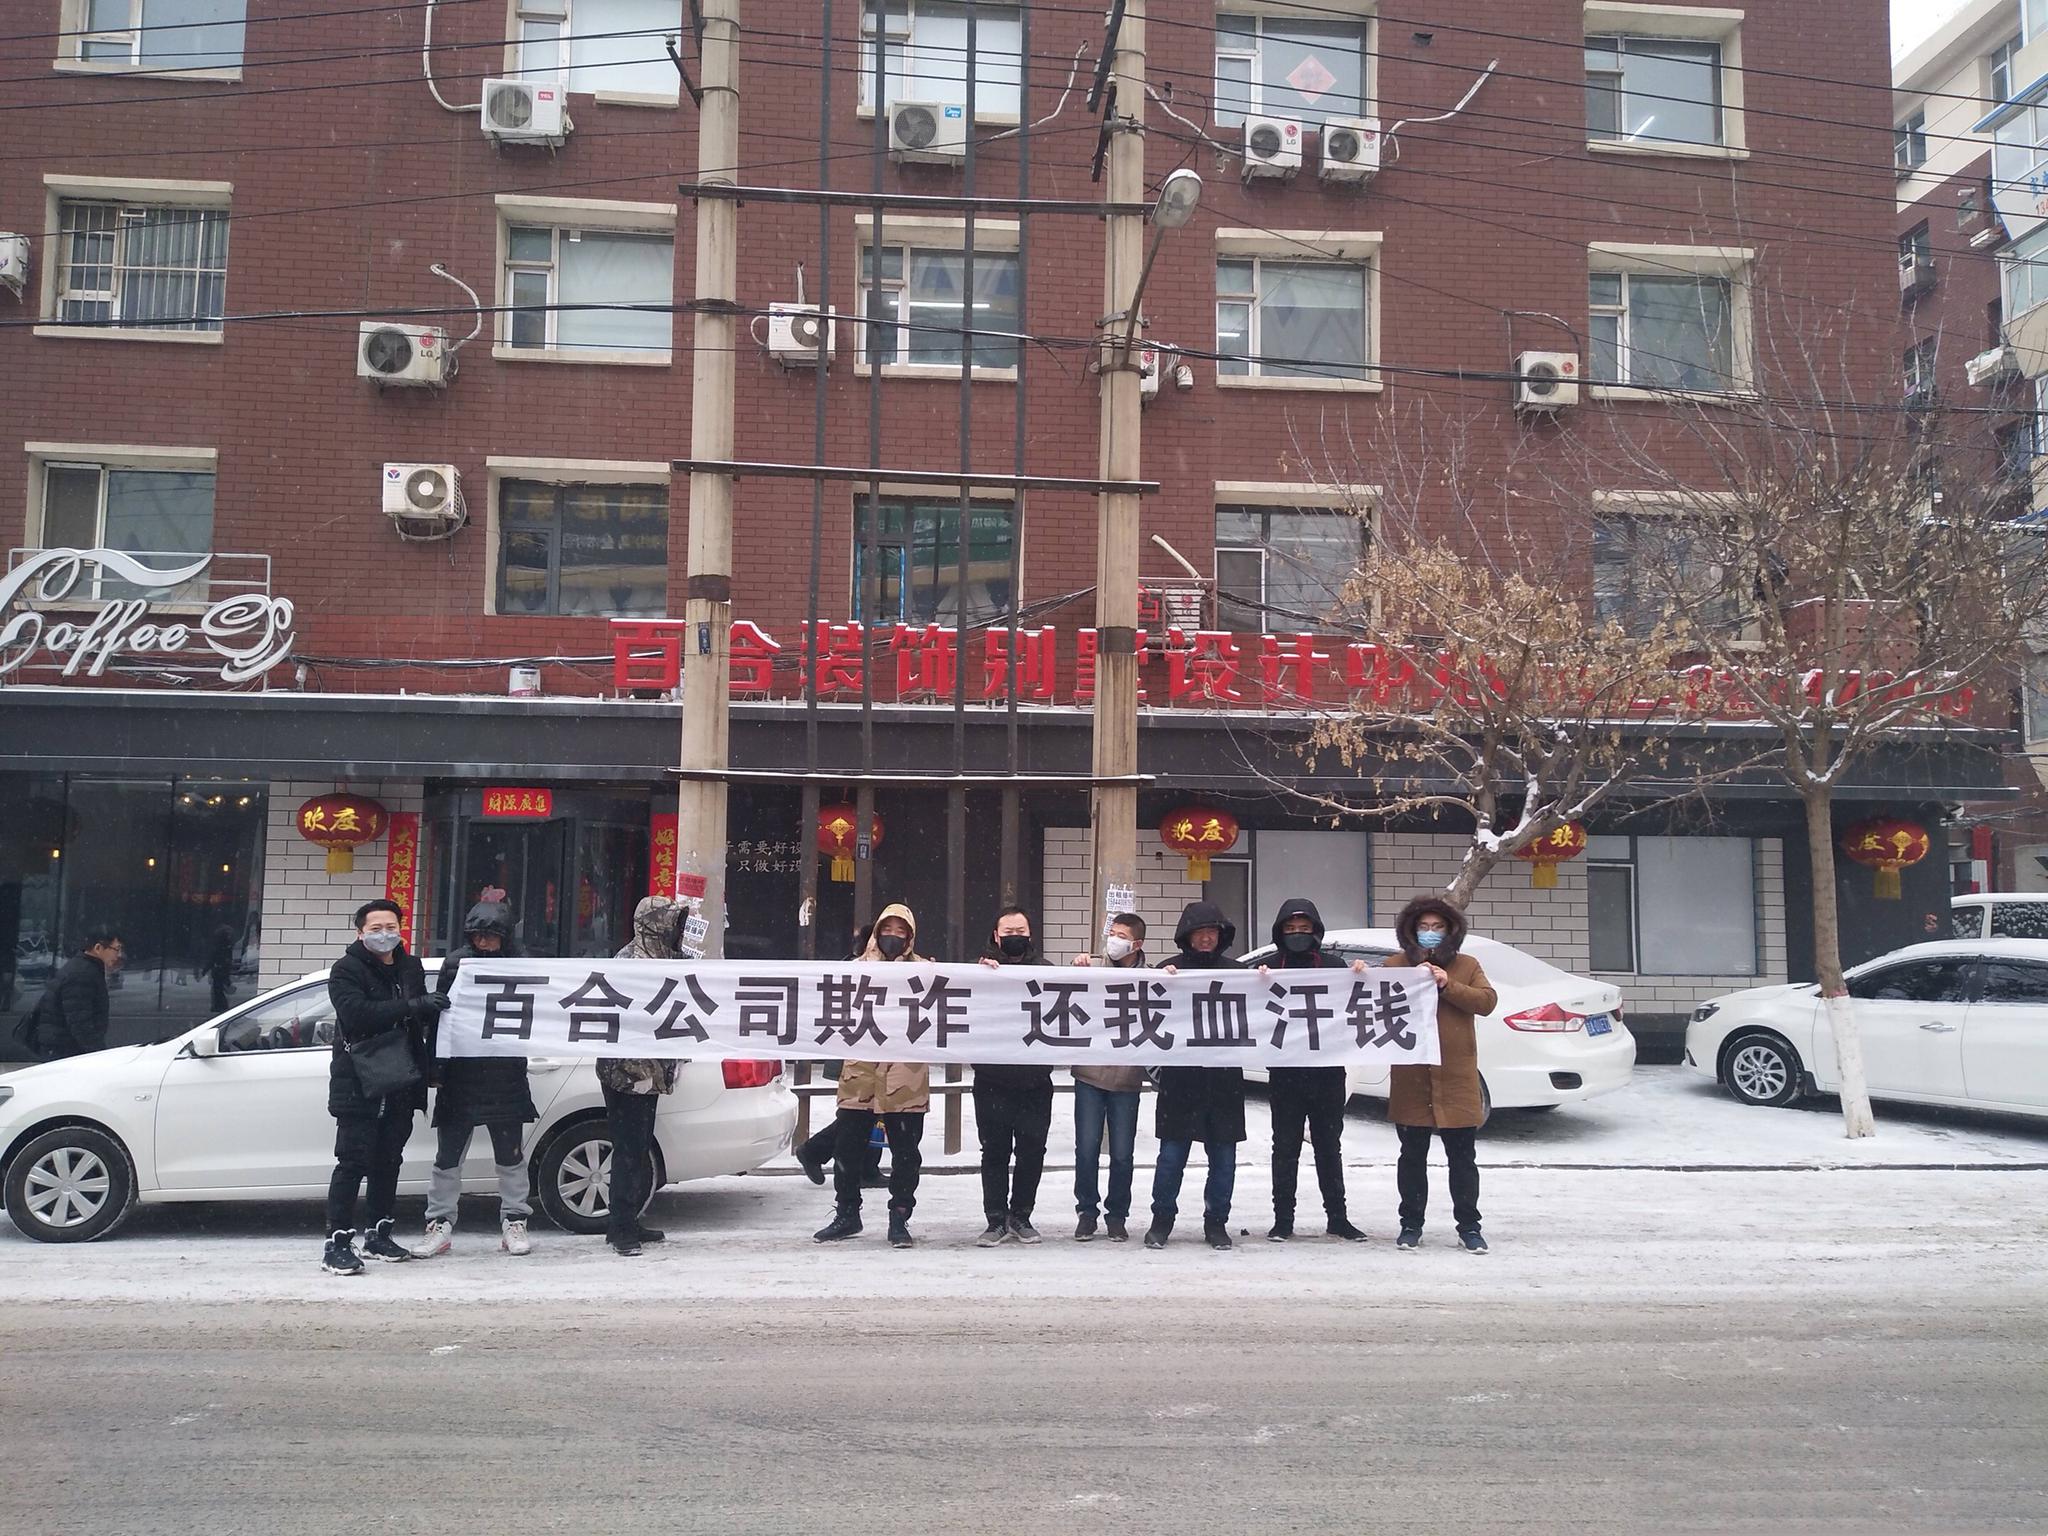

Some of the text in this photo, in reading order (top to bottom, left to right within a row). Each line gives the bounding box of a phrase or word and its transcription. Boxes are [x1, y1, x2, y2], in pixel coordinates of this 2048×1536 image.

[420, 349, 433, 357] LG
[304, 806, 361, 832] 欢度
[1171, 818, 1225, 842] 欢度
[653, 827, 675, 897] 好生意
[474, 971, 1417, 1051] 百合公司欺诈 还我血汗钱
